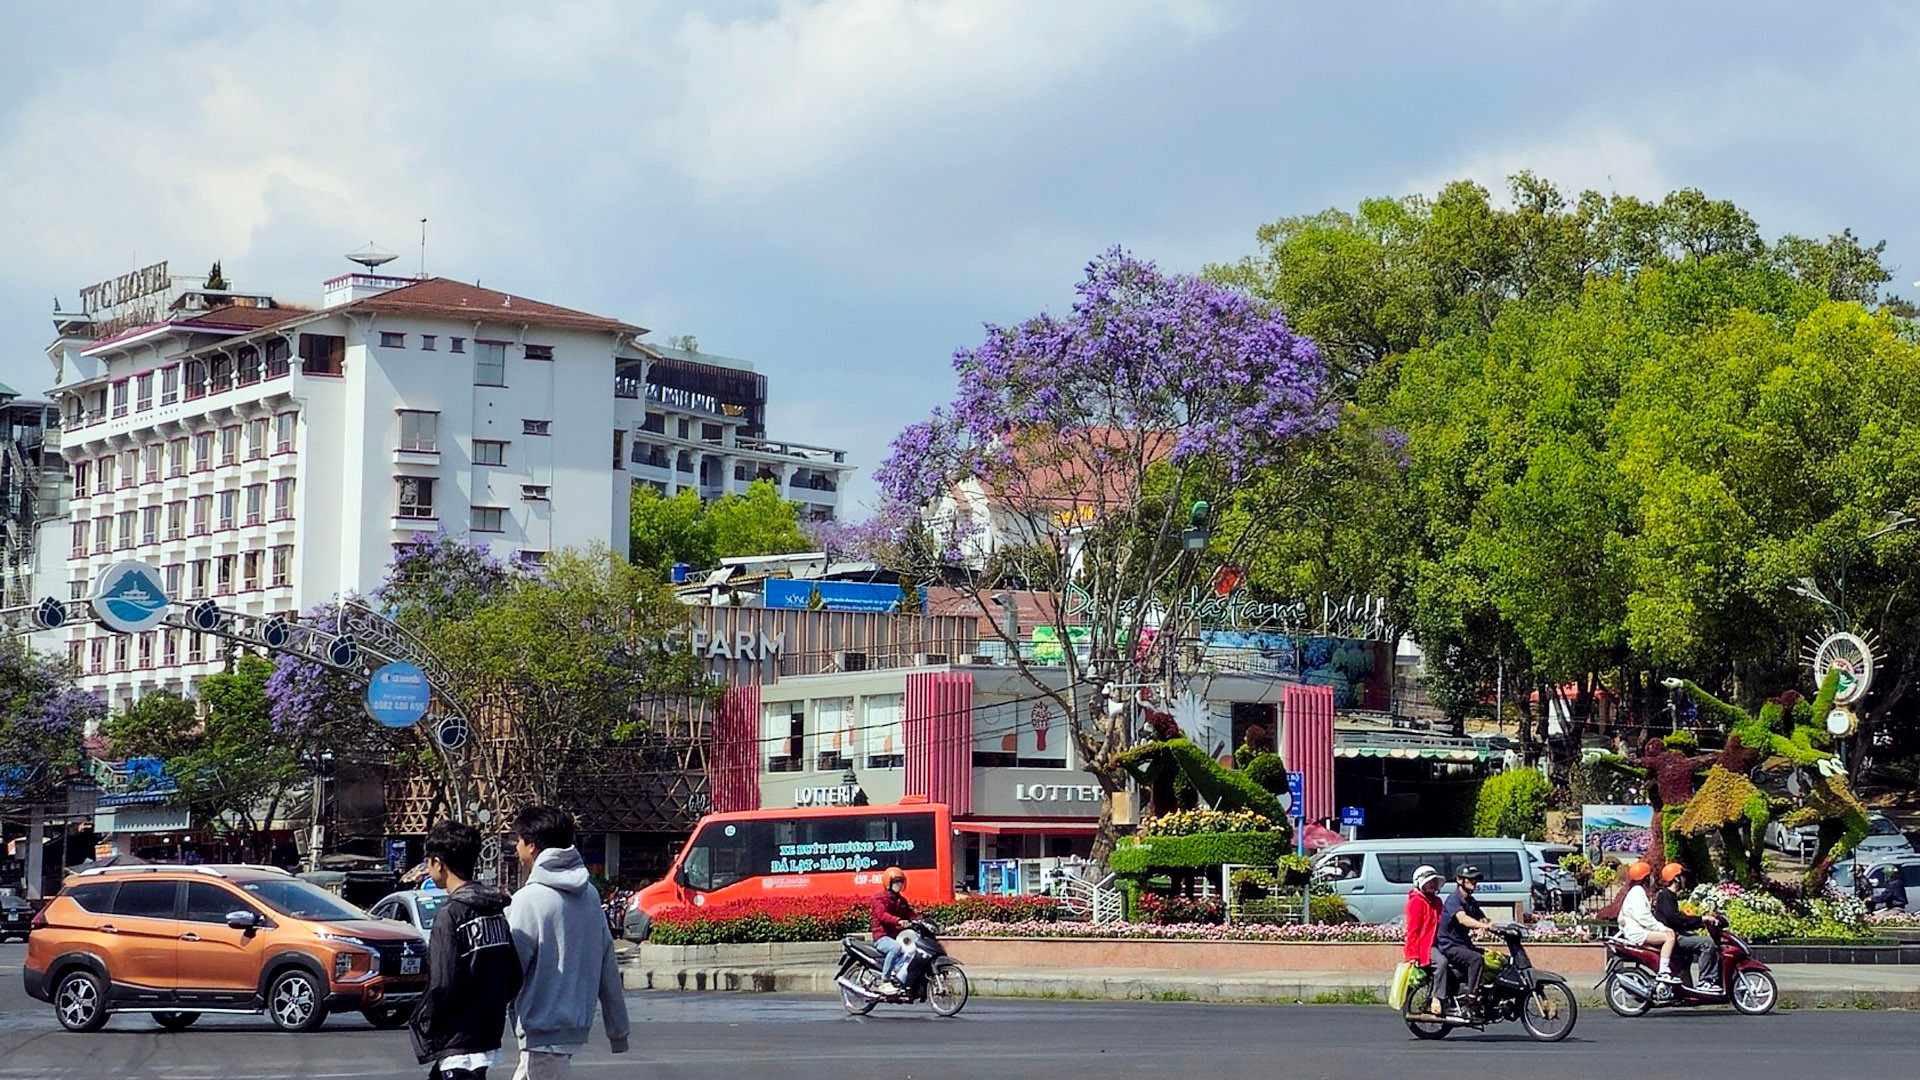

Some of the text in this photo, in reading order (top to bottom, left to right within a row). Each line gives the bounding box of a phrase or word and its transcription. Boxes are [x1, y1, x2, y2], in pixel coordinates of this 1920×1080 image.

[80, 261, 171, 315] TTC HOTEL
[779, 845, 796, 856] XE
[796, 842, 828, 855] BUÝT
[874, 840, 915, 851] TRANG
[846, 854, 871, 872] LỘC
